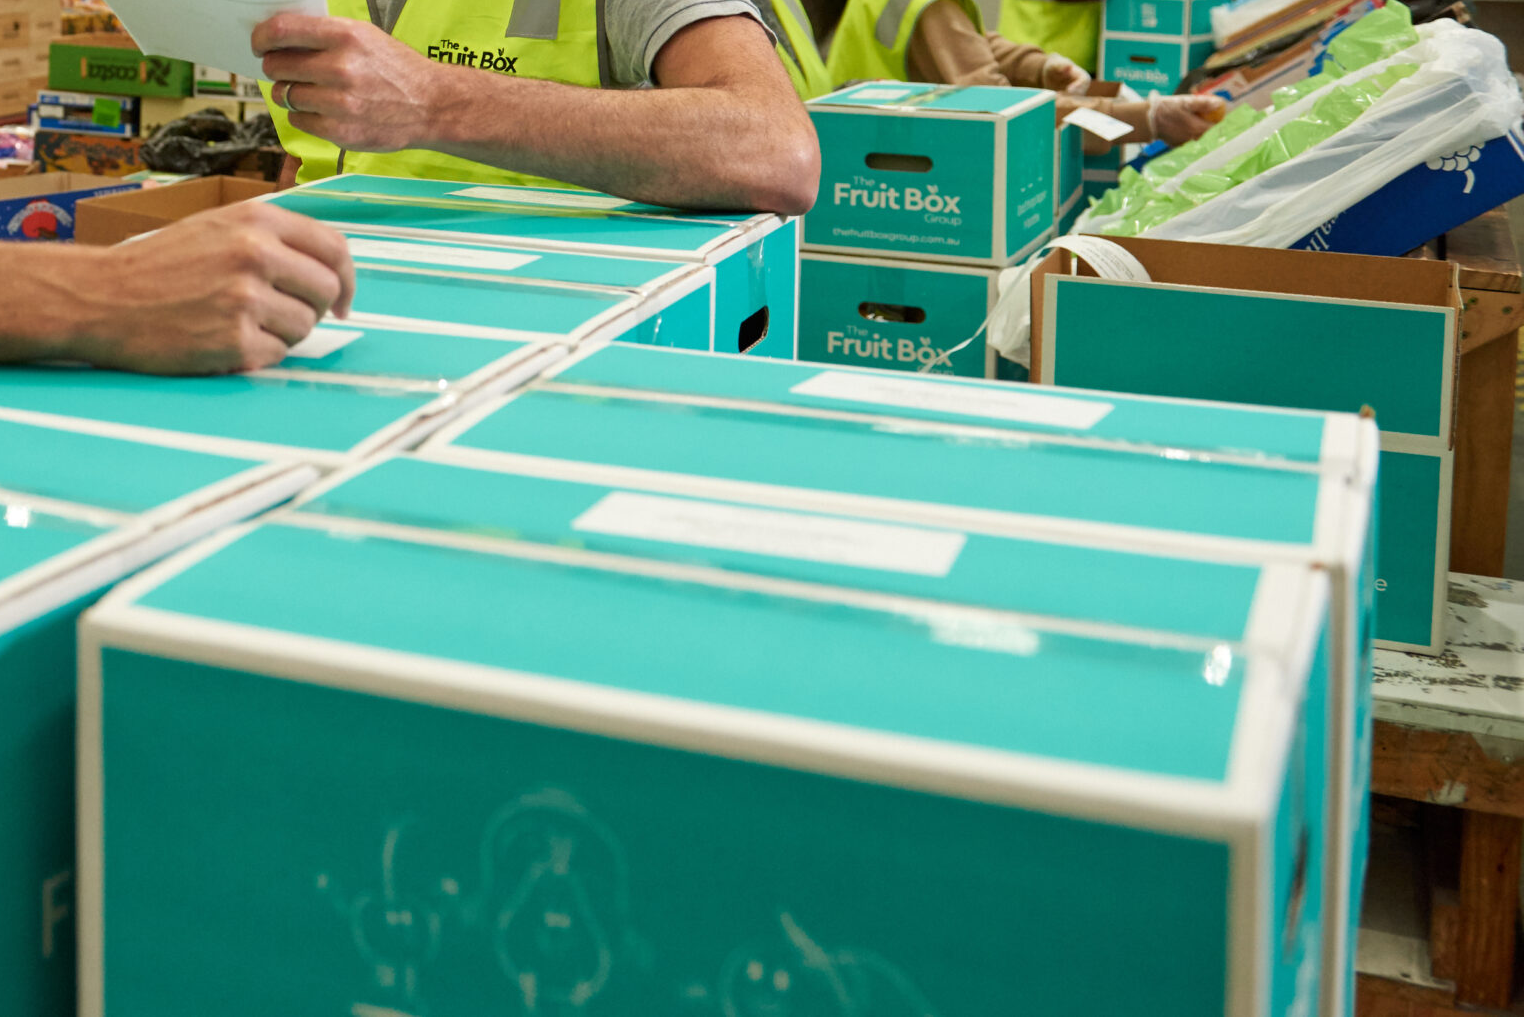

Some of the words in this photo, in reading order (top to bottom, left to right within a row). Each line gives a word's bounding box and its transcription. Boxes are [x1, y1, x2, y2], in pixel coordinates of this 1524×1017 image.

[440, 39, 460, 50] The
[427, 45, 477, 69] Fruit
[479, 49, 518, 73] Box
[853, 176, 875, 187] The
[834, 183, 901, 210] Fruit
[904, 186, 961, 214] Box
[924, 213, 963, 227] Group
[832, 227, 960, 246] thefruitboxgroup.com.au
[847, 325, 869, 336] The
[827, 331, 894, 360] Fruit
[897, 337, 953, 367] Box
